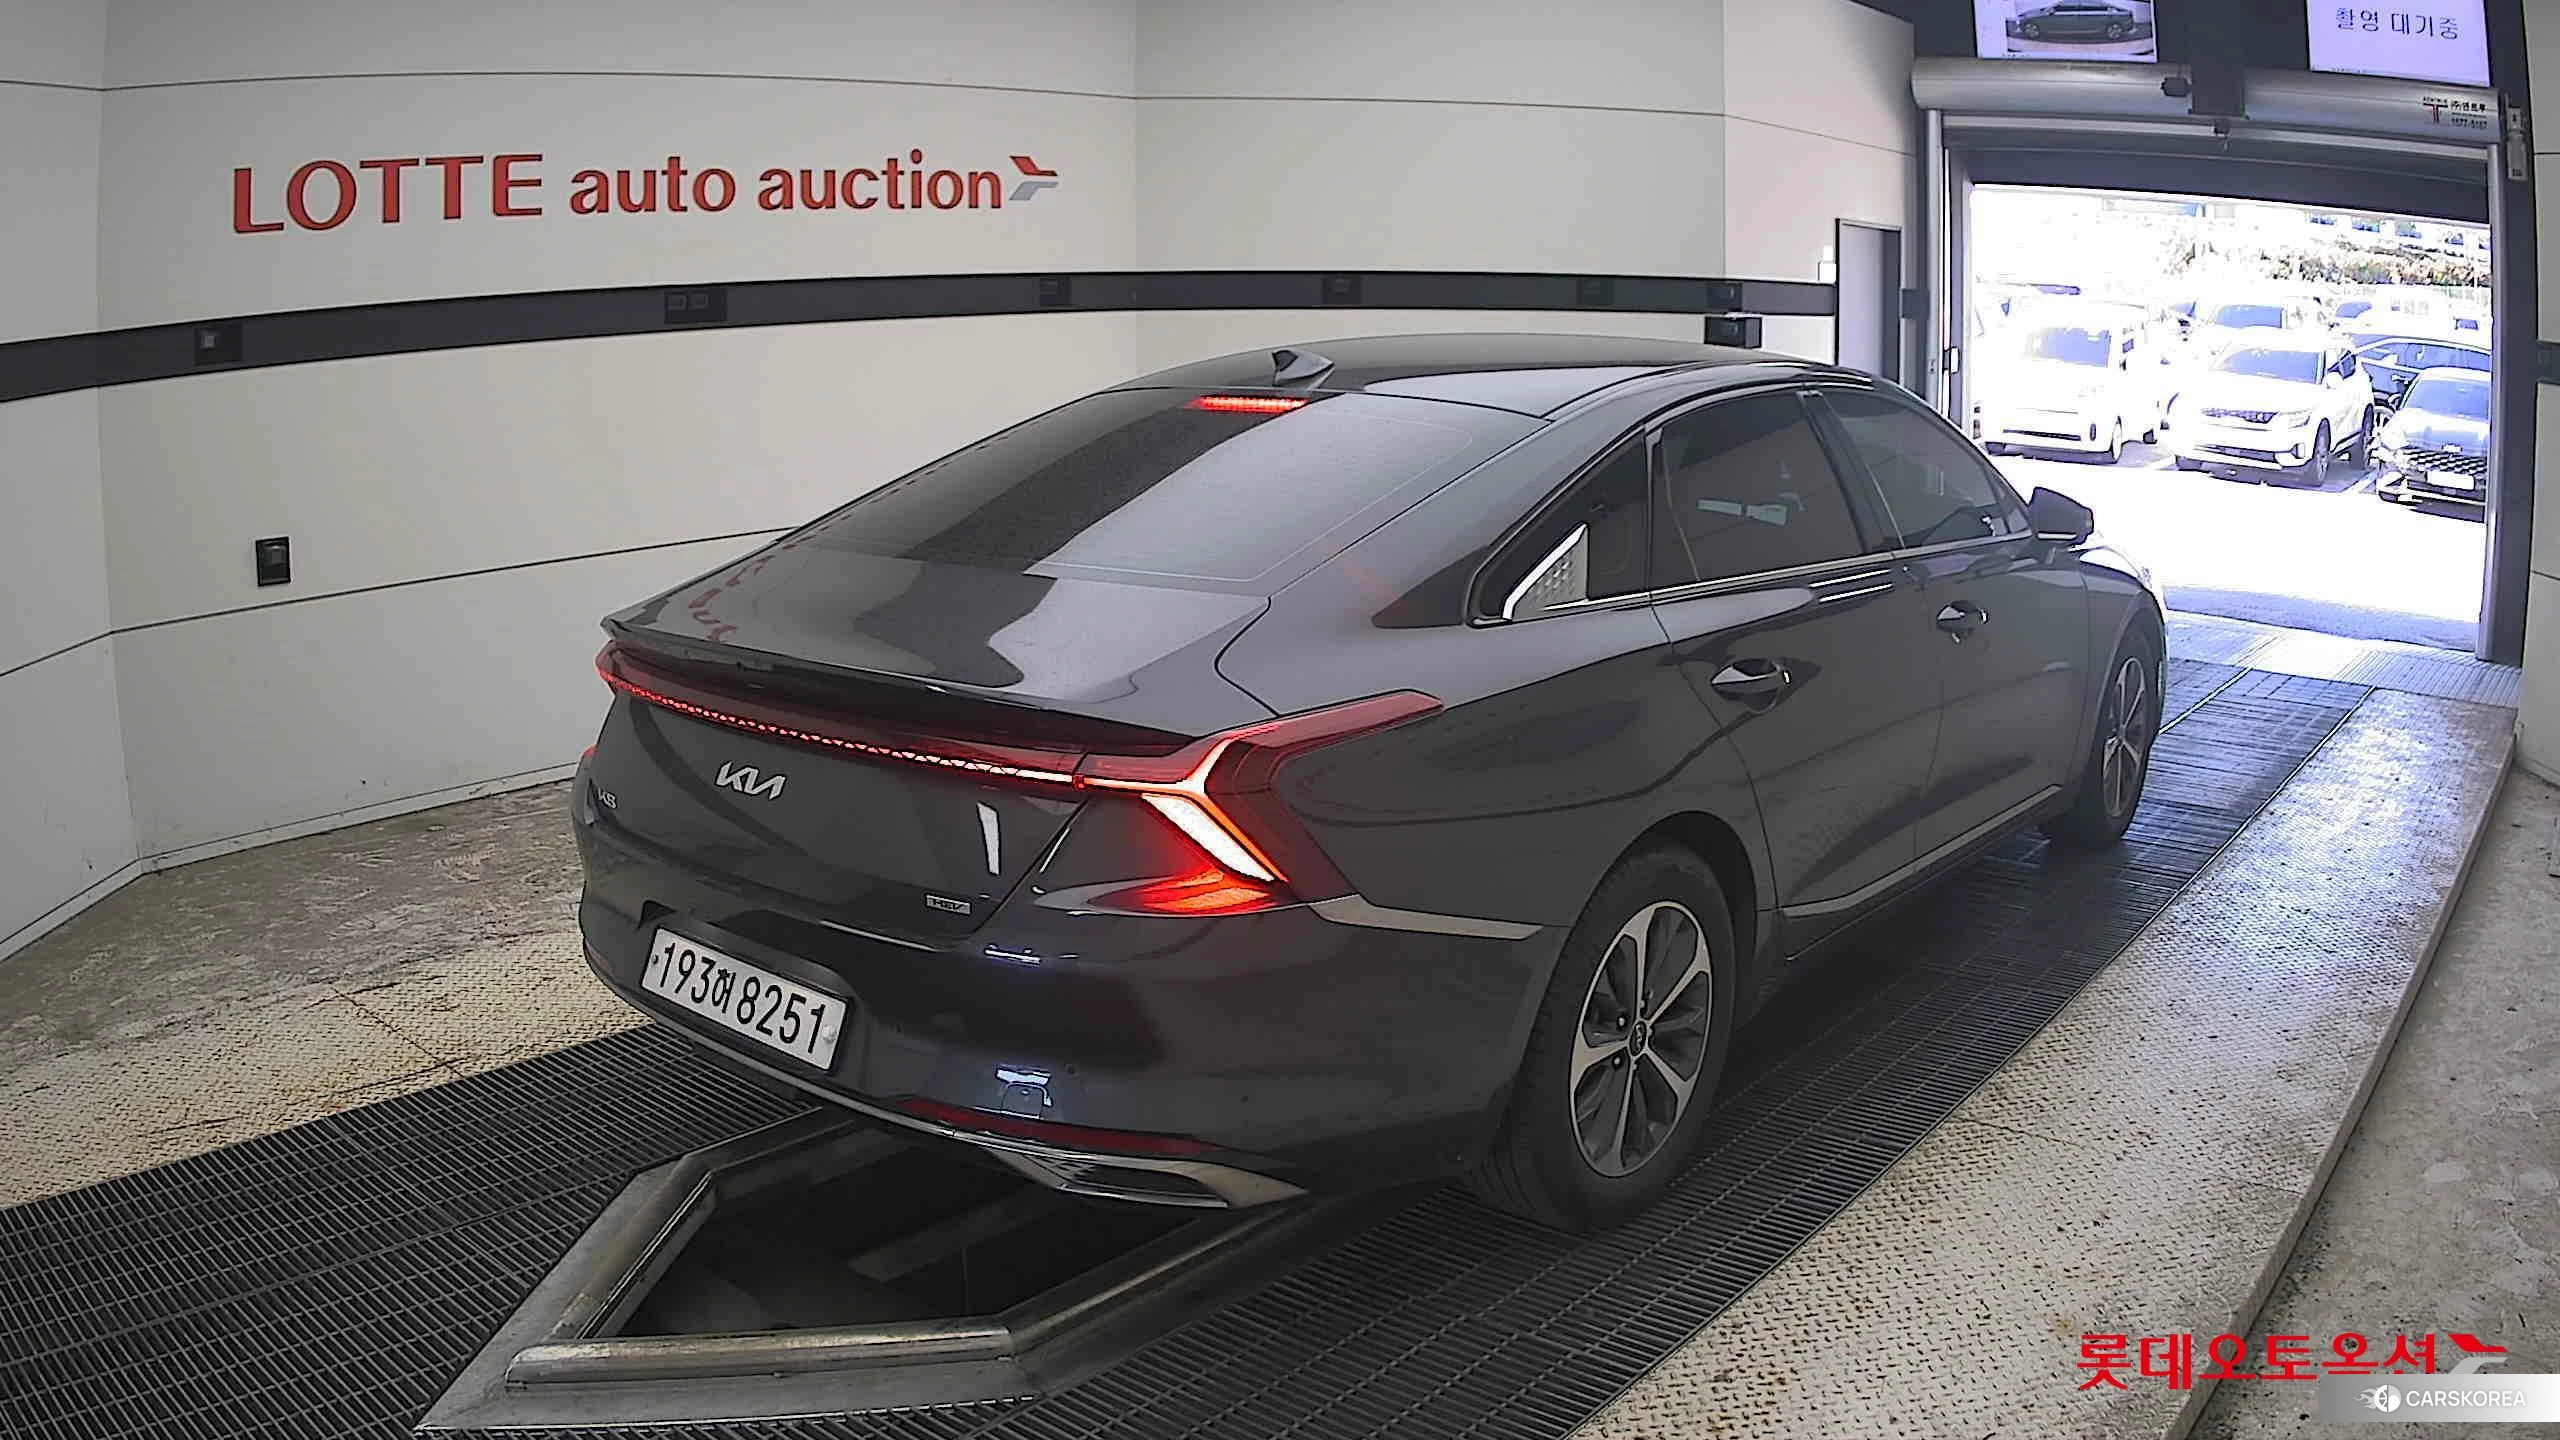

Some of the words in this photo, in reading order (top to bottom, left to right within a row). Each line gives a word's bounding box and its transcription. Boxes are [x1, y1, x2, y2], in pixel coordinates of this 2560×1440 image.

[2391, 12, 2458, 40] 대기중
[234, 153, 543, 234] LOTTE
[570, 155, 737, 214] auto
[758, 148, 1001, 212] auction
